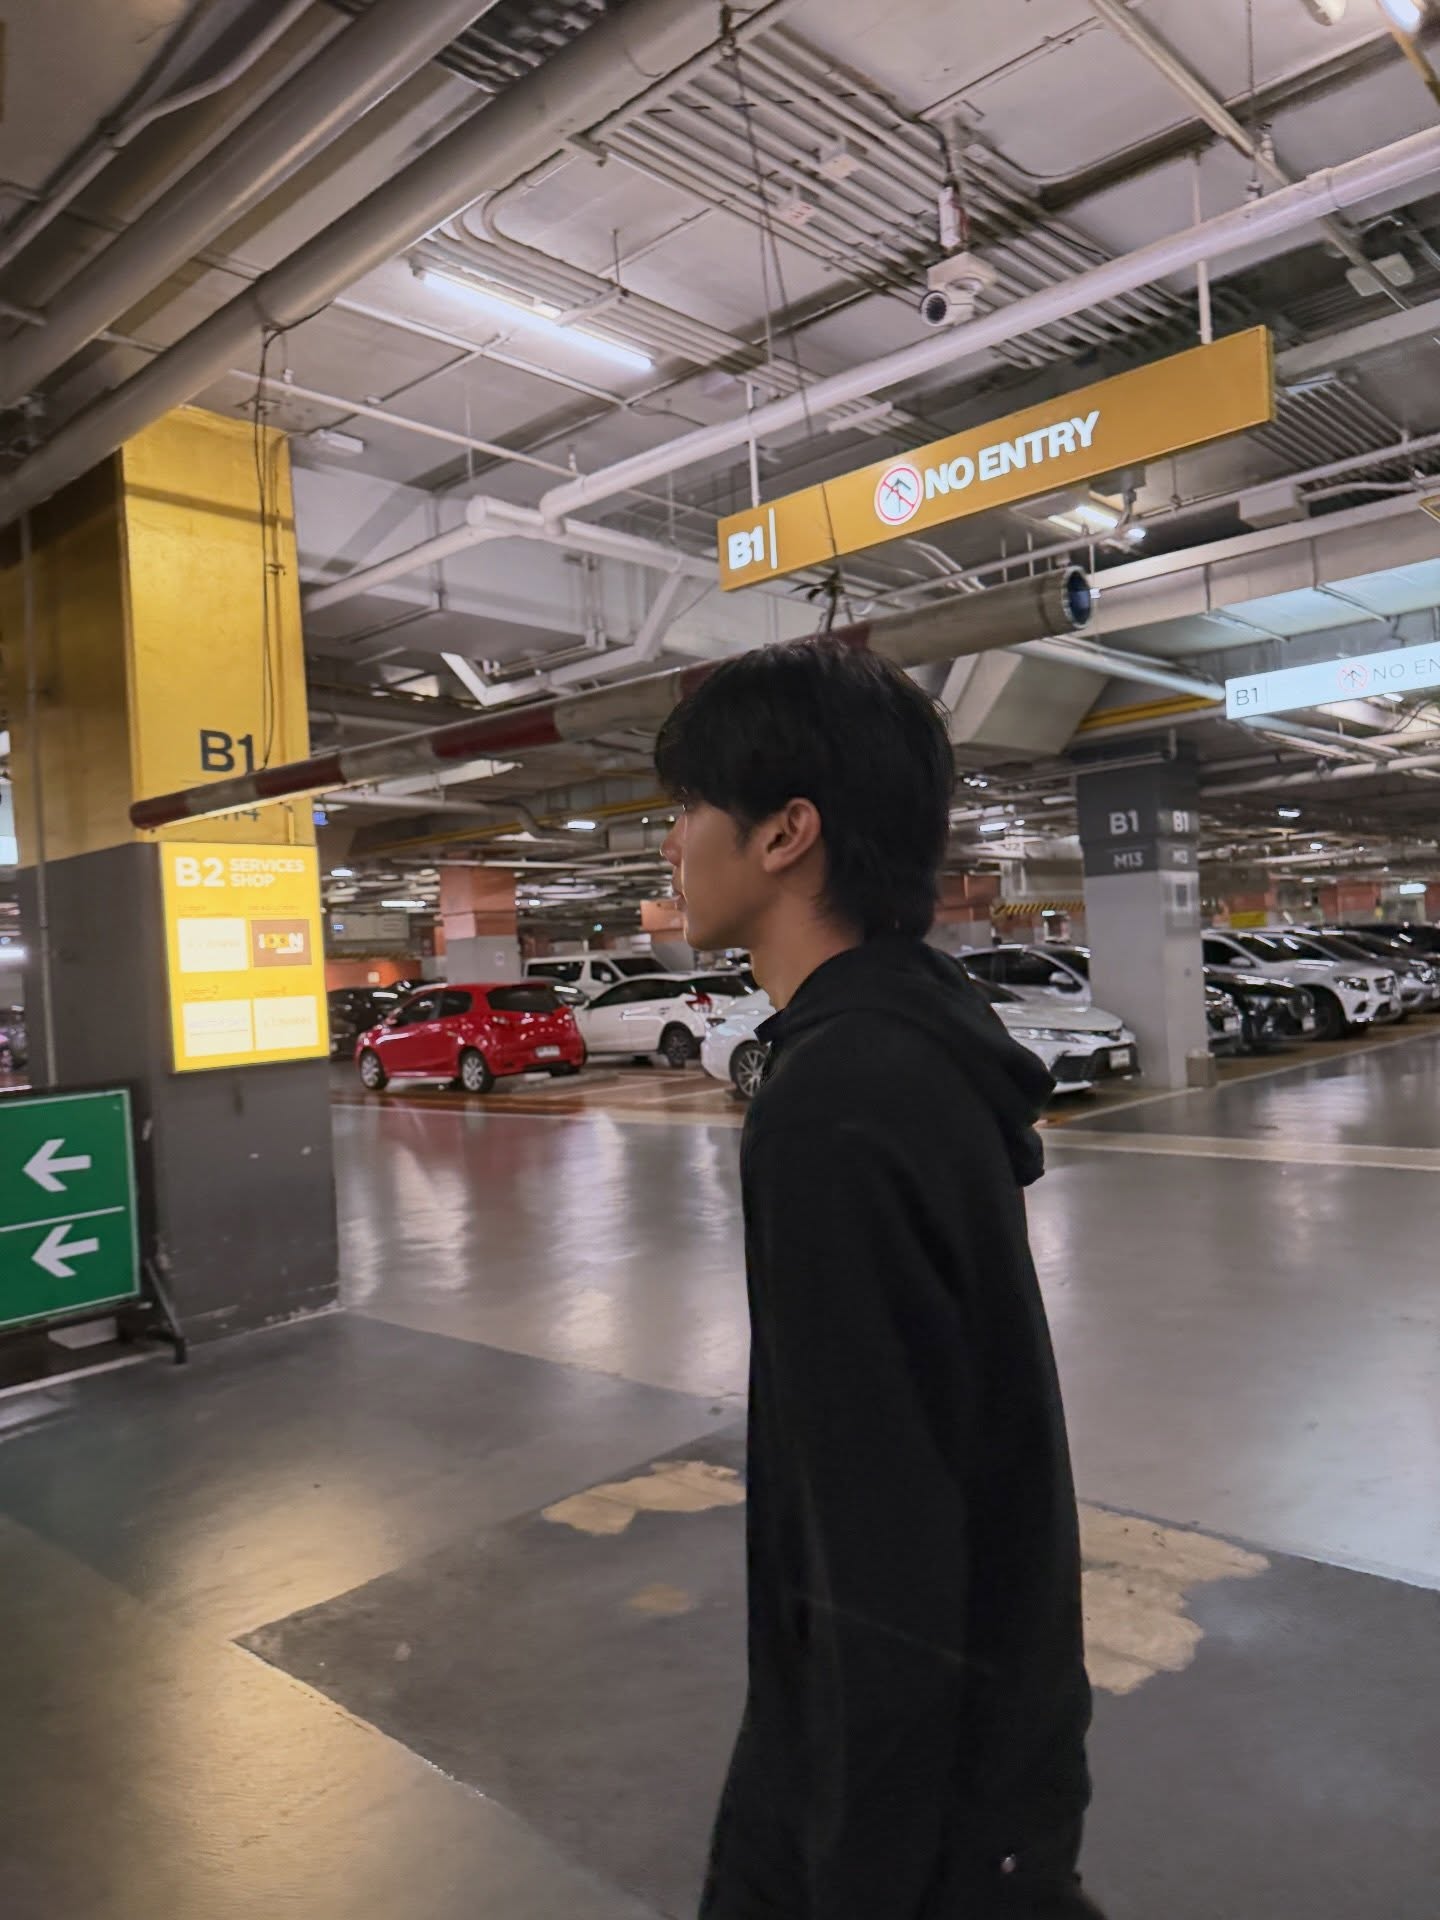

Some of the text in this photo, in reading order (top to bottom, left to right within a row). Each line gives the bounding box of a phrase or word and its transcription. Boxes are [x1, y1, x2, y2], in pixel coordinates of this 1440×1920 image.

[924, 410, 1100, 500] NO ENTRY
[727, 526, 764, 571] B1
[1373, 663, 1405, 682] NO
[1235, 687, 1259, 707] B1
[200, 729, 255, 775] B1
[1109, 809, 1139, 835] B1
[1173, 810, 1189, 833] B1
[175, 856, 304, 888] B2 SERVICES
[230, 873, 275, 888] SHOP
